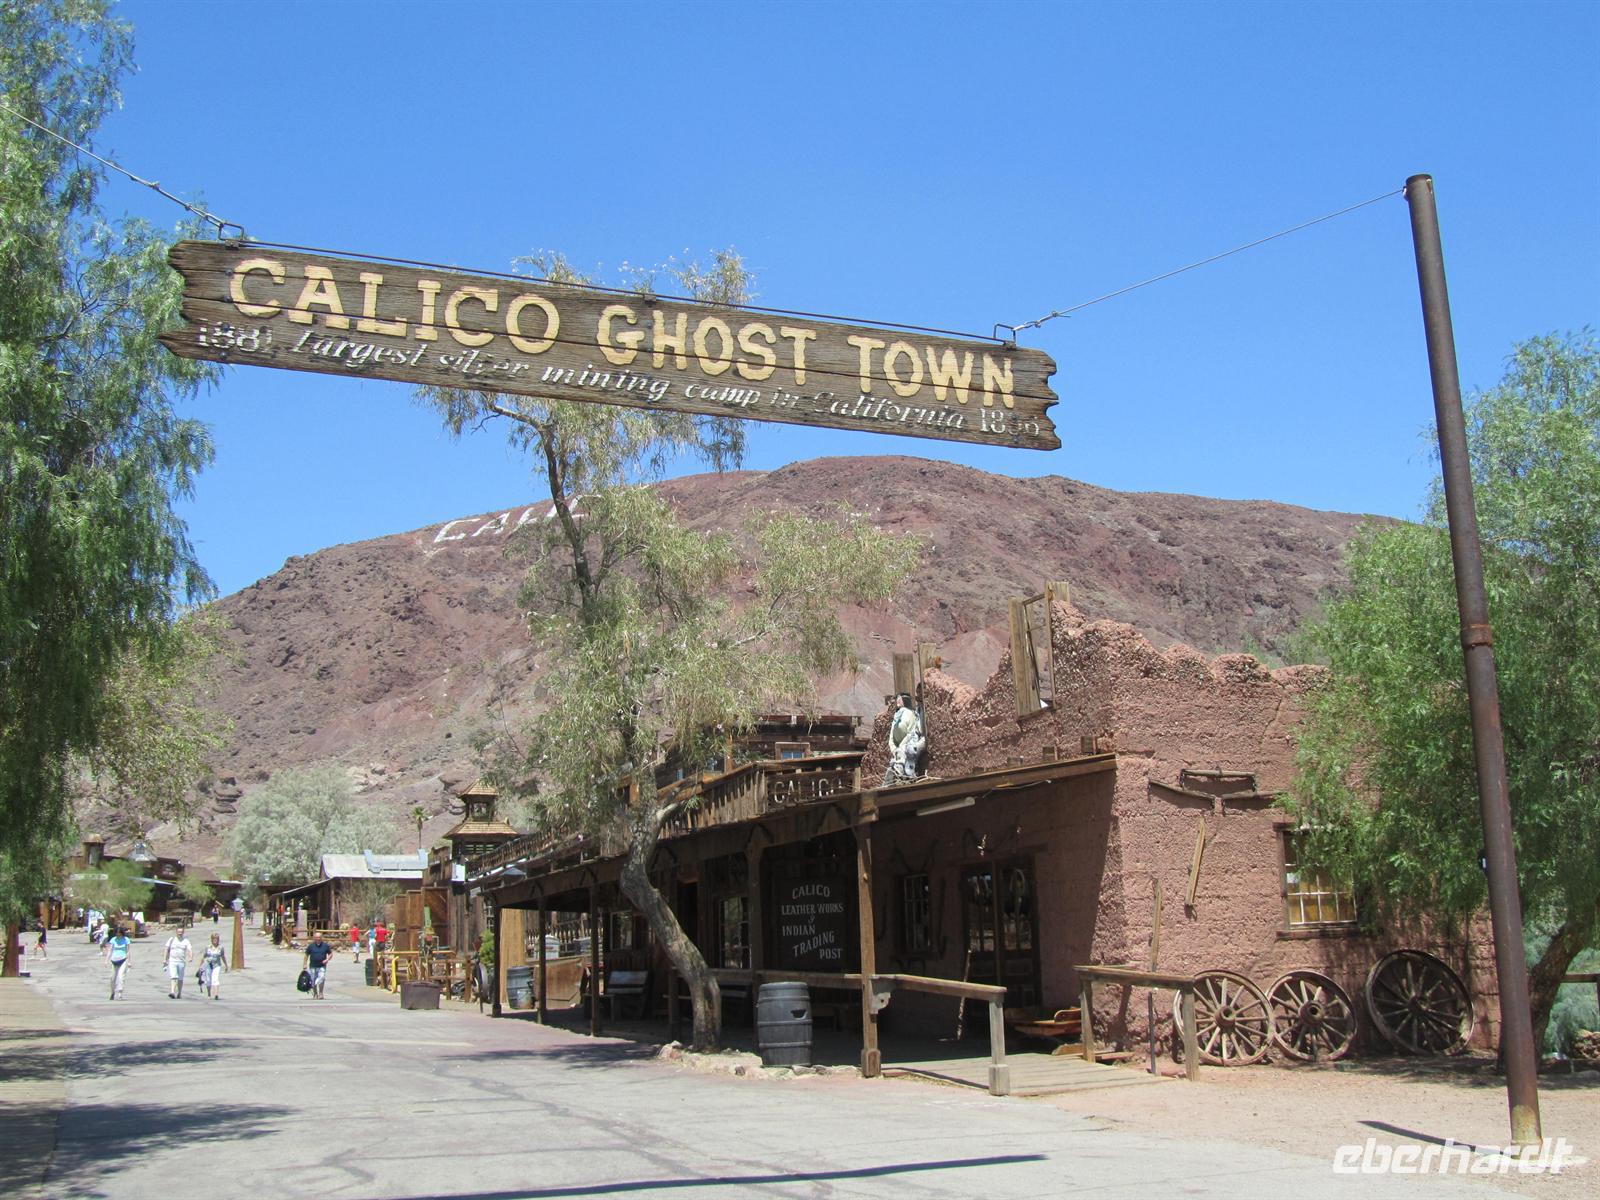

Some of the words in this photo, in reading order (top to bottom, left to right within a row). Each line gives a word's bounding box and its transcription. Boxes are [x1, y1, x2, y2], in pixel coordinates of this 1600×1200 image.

[229, 257, 560, 355] CALICO
[596, 303, 816, 386] GHOST
[847, 334, 1015, 409] TOWN
[540, 363, 671, 402] mining
[684, 383, 761, 408] camp
[813, 391, 965, 429] California
[791, 883, 831, 900] CALICO
[781, 903, 816, 916] LEATHER
[817, 902, 845, 915] WORKS
[782, 924, 816, 937] INDIAN
[793, 931, 835, 957] TRADING
[819, 948, 844, 960] POST
